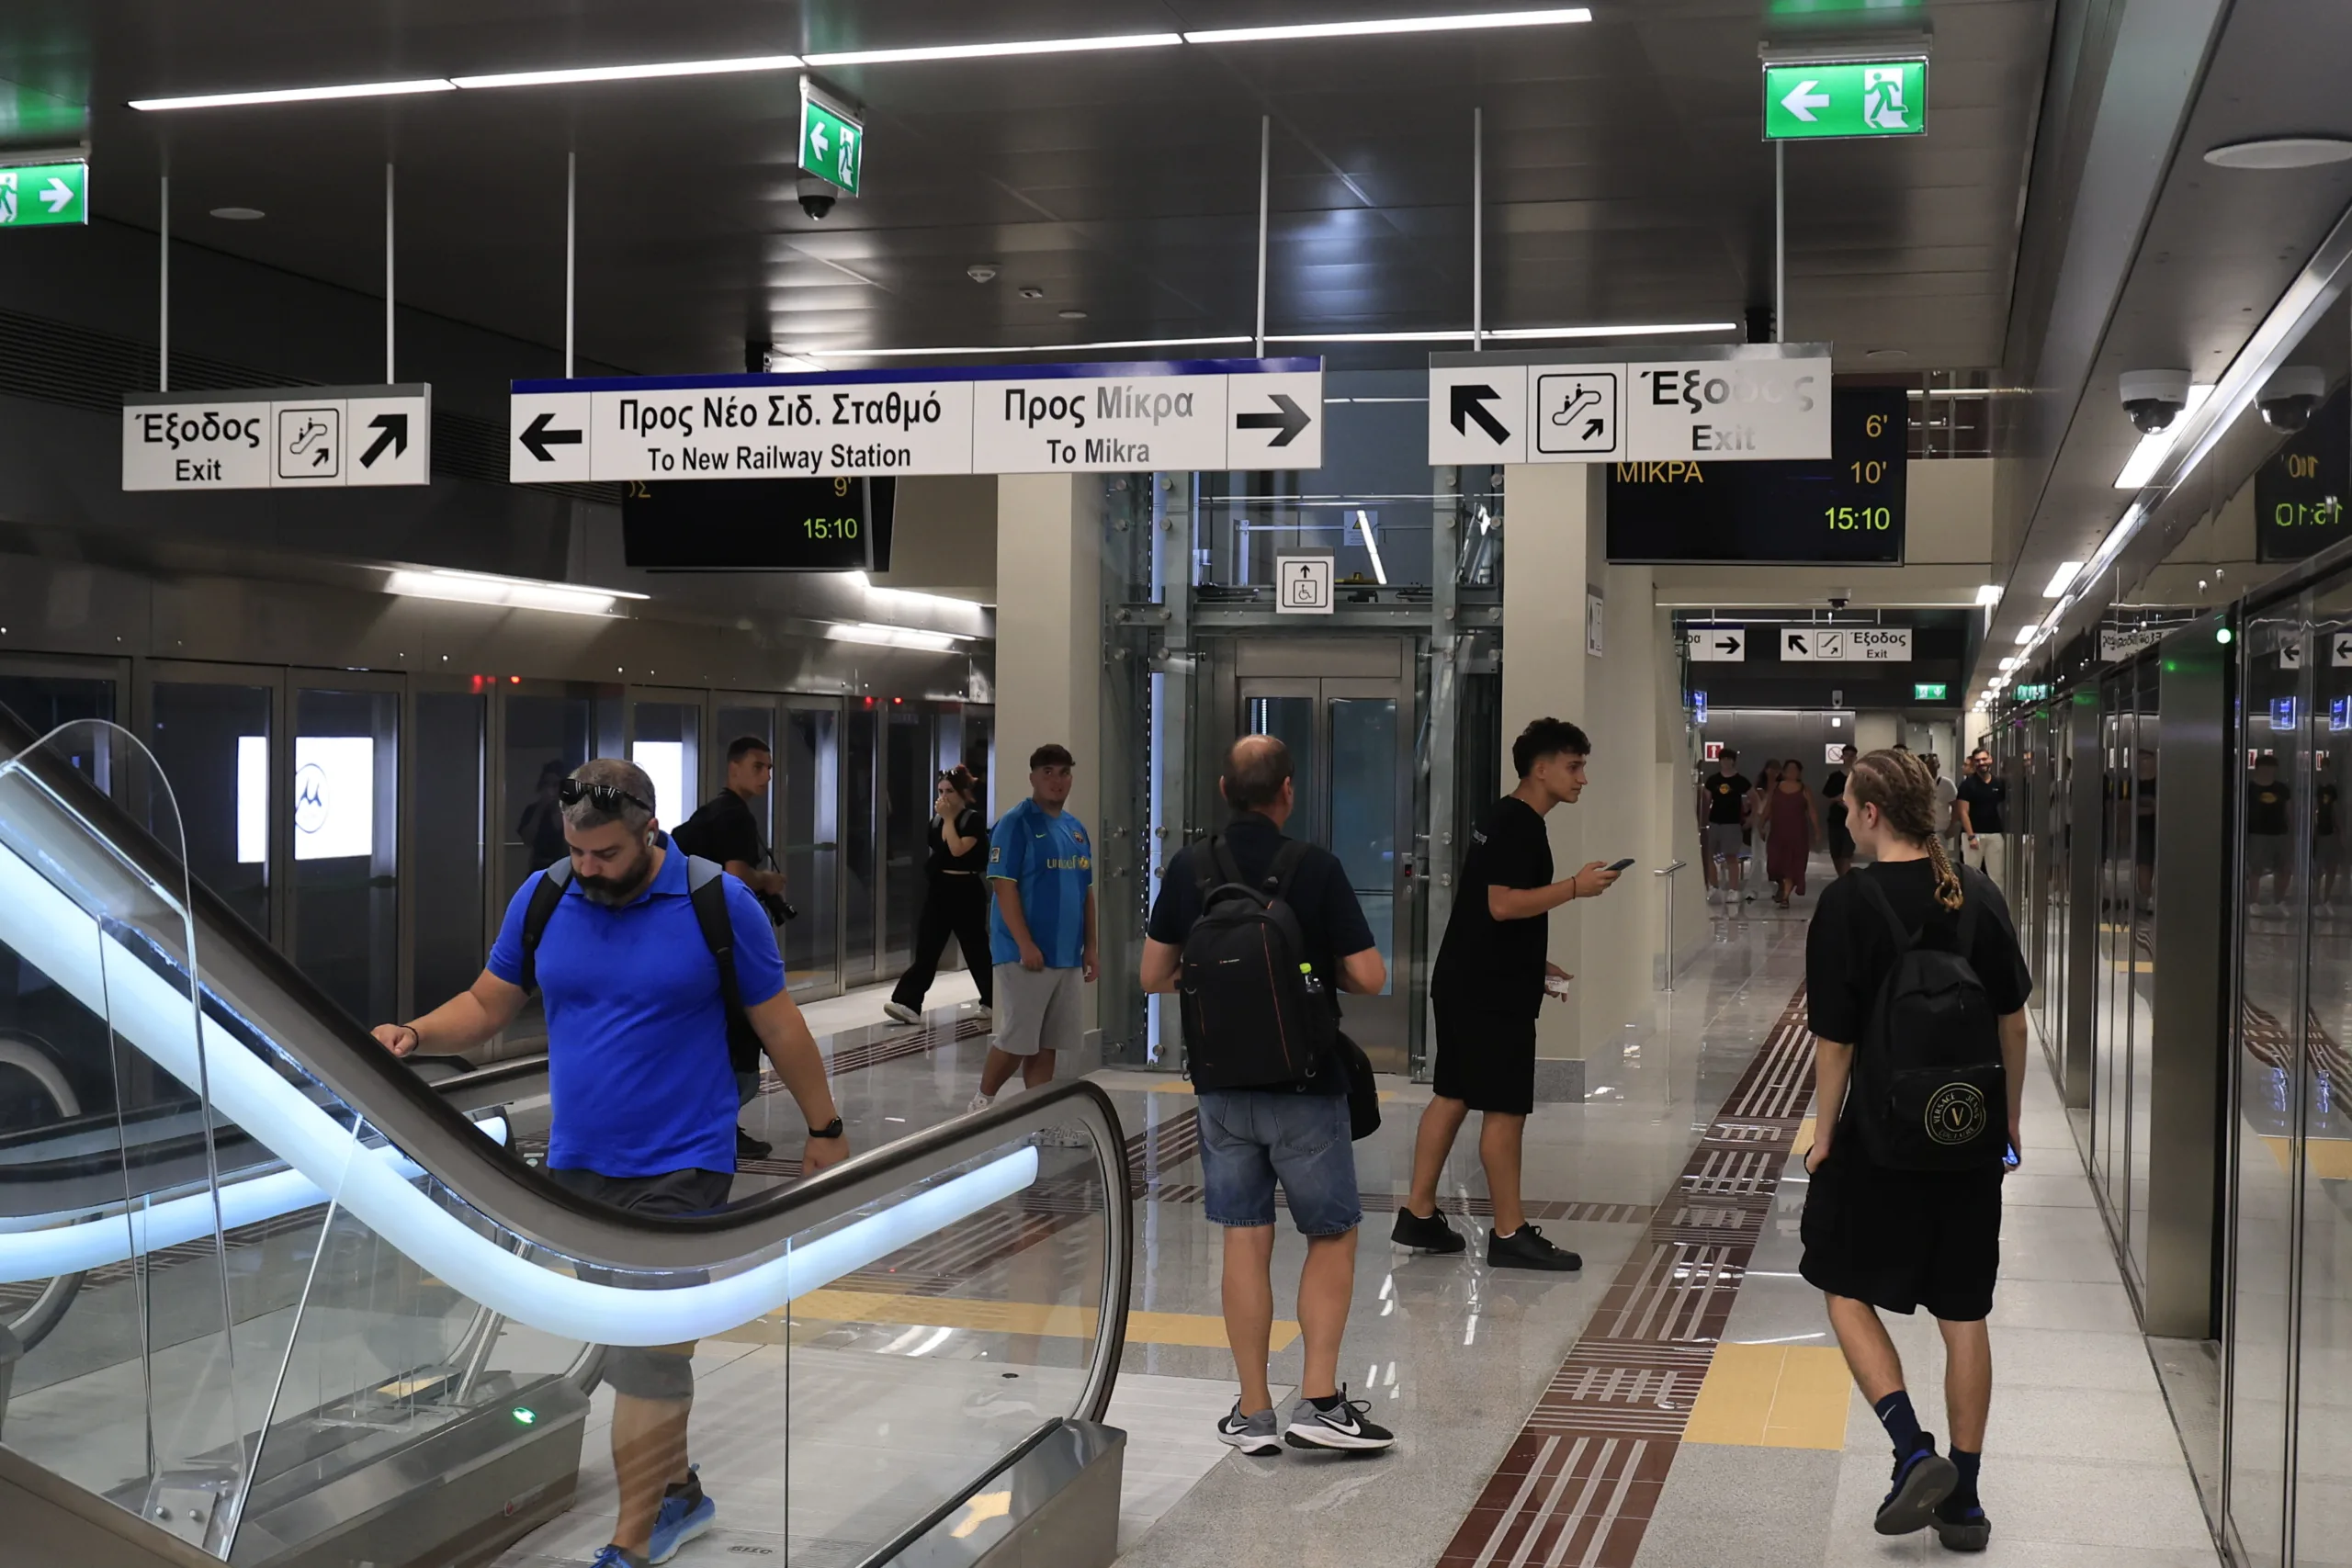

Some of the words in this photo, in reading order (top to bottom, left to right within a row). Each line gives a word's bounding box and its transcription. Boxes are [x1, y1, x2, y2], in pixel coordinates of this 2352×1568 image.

[620, 400, 693, 437] Προς
[704, 396, 757, 428] Νέο
[768, 394, 820, 426] Σιδ.
[832, 390, 941, 432] Σταθμό
[1006, 389, 1085, 429] Προς
[1097, 386, 1193, 426] Μίκρα
[135, 412, 260, 450] Έξοδος
[1691, 424, 1756, 451] Exit
[1867, 415, 1887, 437] 6'
[648, 448, 674, 471] To
[683, 447, 729, 470] New
[737, 446, 822, 474] Railway
[831, 444, 910, 468] Station
[1046, 440, 1076, 464] To
[1085, 438, 1148, 463] Mikra
[176, 459, 221, 481] Exit
[1851, 461, 1886, 483] 10'
[804, 518, 857, 538] 15:10
[1826, 507, 1890, 530] 15:10
[1850, 632, 1905, 647] Έξοδος
[1866, 649, 1889, 659] Exit
[1933, 1091, 1956, 1124] VERSACE
[1951, 1107, 1964, 1126] V
